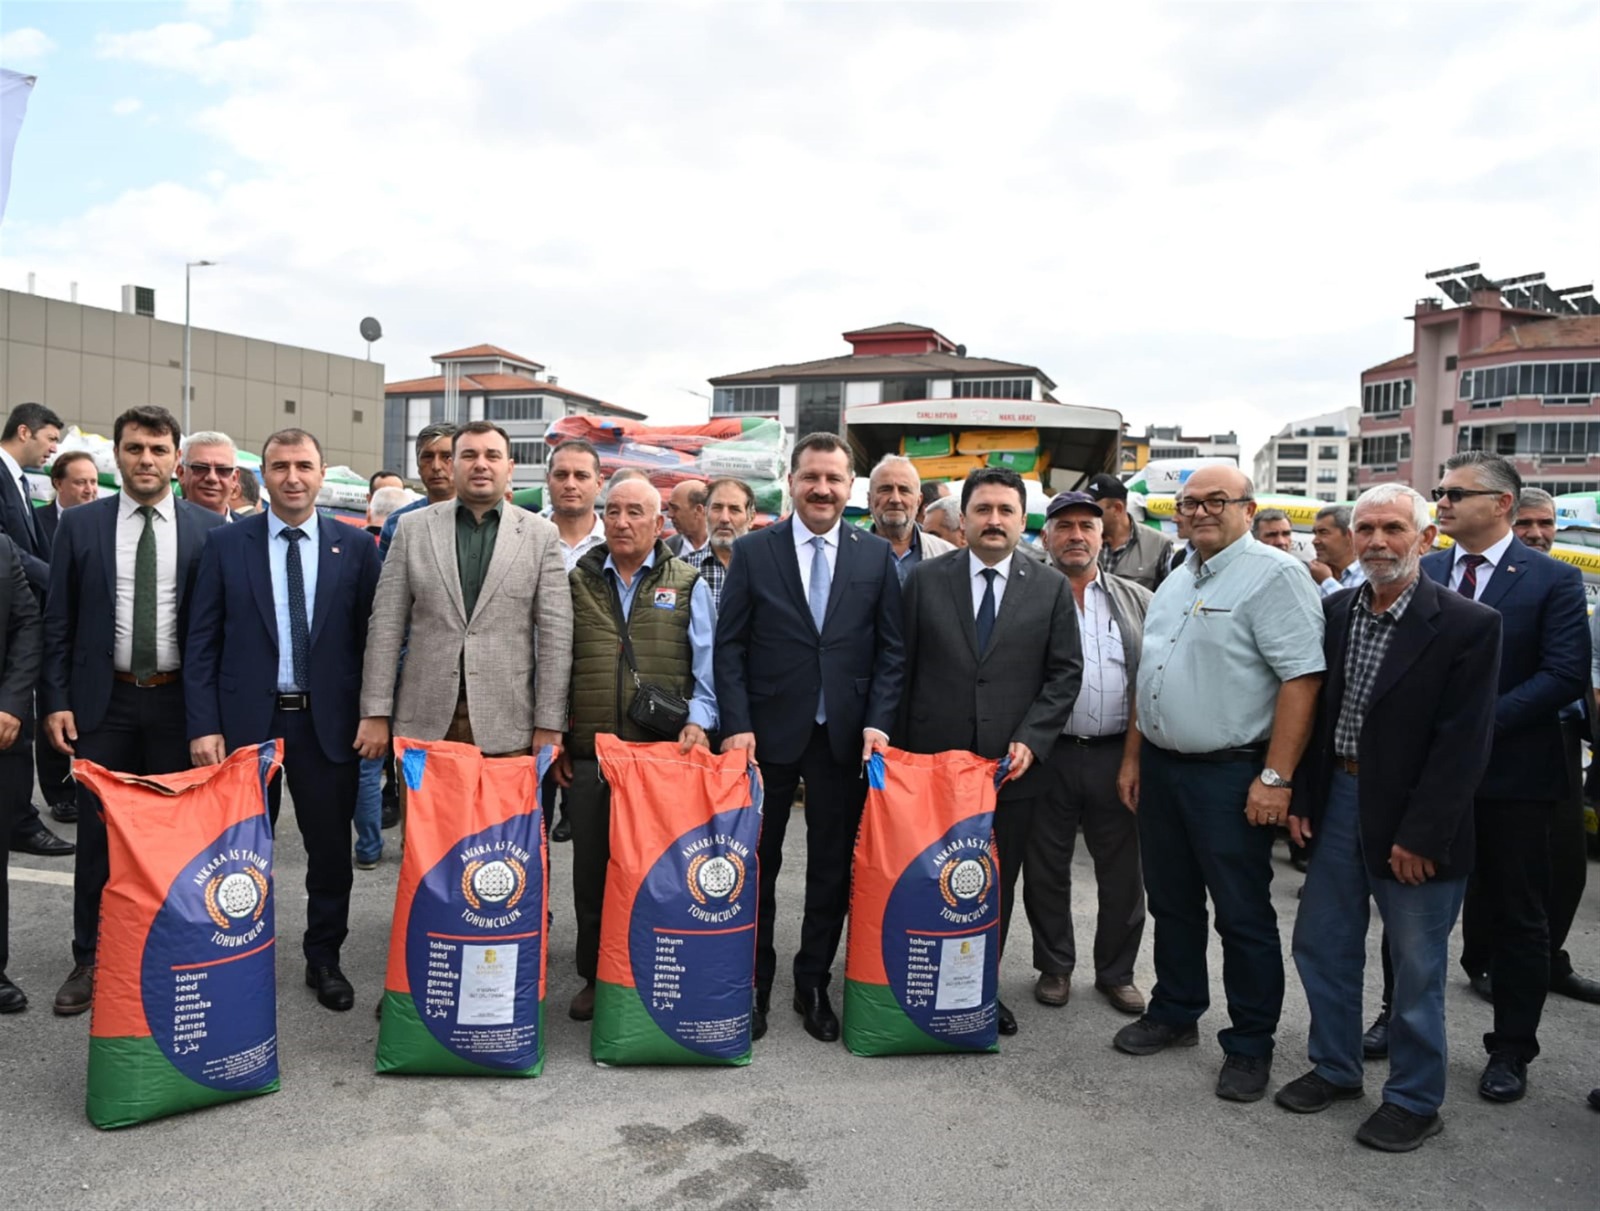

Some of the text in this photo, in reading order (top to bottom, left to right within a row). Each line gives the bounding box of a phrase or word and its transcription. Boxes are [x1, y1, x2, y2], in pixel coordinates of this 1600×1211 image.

[682, 834, 749, 860] ANKARA AS TARIM
[494, 841, 505, 851] AS
[507, 841, 530, 863] TARIM
[933, 839, 965, 867] ANKARA
[967, 838, 977, 848] AS
[194, 854, 228, 887] ANKARA
[230, 850, 239, 860] AS
[688, 902, 742, 923] TOHUMCULUK
[940, 902, 989, 923] TOHUMCULUK
[461, 908, 522, 928] TOHUMCULUK
[211, 920, 265, 947] TOHUMCULUK
[657, 937, 683, 945] tohum
[910, 938, 936, 946] tohum
[430, 941, 456, 951] tohum
[656, 946, 674, 954] seed
[429, 961, 449, 969] seme
[176, 972, 208, 982] tohum
[654, 973, 679, 981] germe
[908, 972, 933, 980] germe
[176, 982, 198, 992] seed
[427, 979, 453, 988] germe
[653, 982, 679, 990] samen
[427, 988, 453, 997] samen
[653, 991, 681, 999] semilla
[907, 988, 934, 996] semilla
[175, 993, 200, 1002] seme
[426, 997, 454, 1006] semilla
[174, 1012, 205, 1024] germe
[174, 1022, 205, 1031] samen
[174, 1030, 207, 1041] semilla
